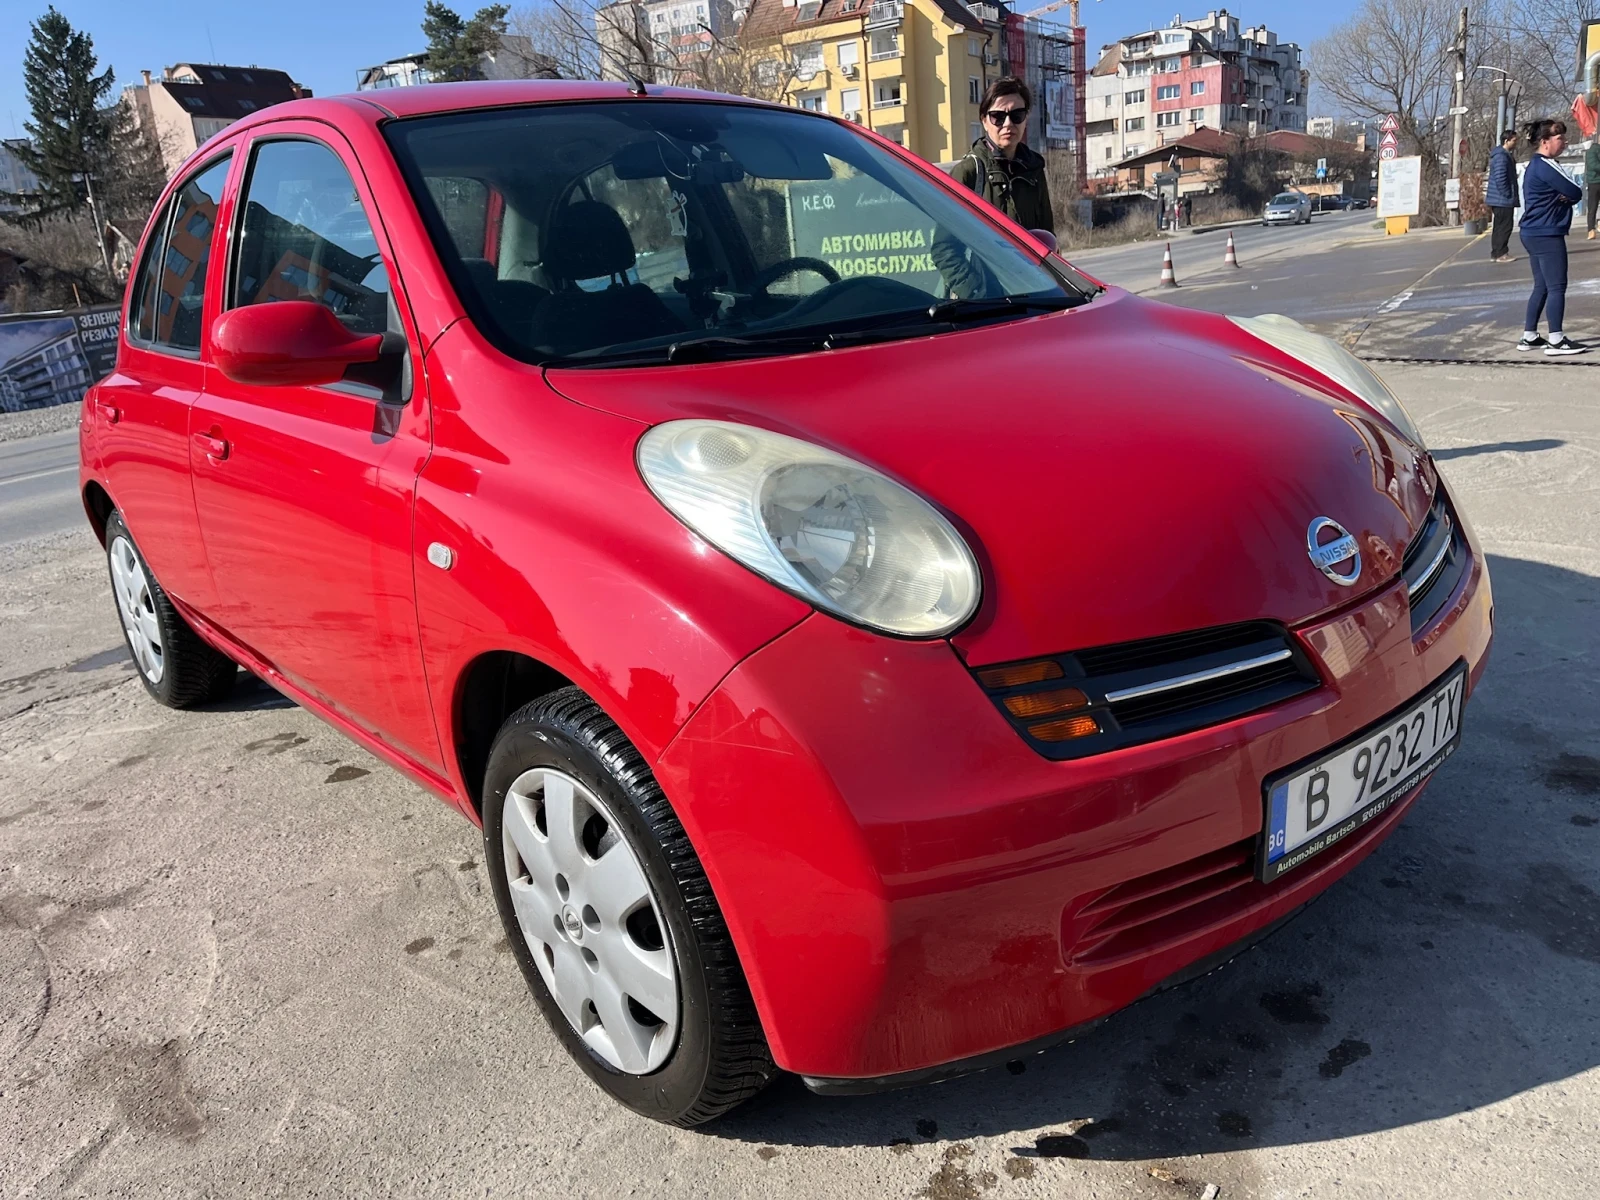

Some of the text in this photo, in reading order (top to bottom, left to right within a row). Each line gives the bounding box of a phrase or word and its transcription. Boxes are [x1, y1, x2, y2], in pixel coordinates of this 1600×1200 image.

[1383, 149, 1393, 158] 30
[821, 229, 926, 255] АВТОМИВКА
[81, 324, 119, 342] РЕЗИД
[1320, 539, 1358, 561] NISSAN
[1307, 680, 1459, 832] B 9232 TX
[1268, 829, 1284, 852] BG
[1277, 841, 1324, 874] Automobile
[1326, 820, 1356, 845] Bartsch
